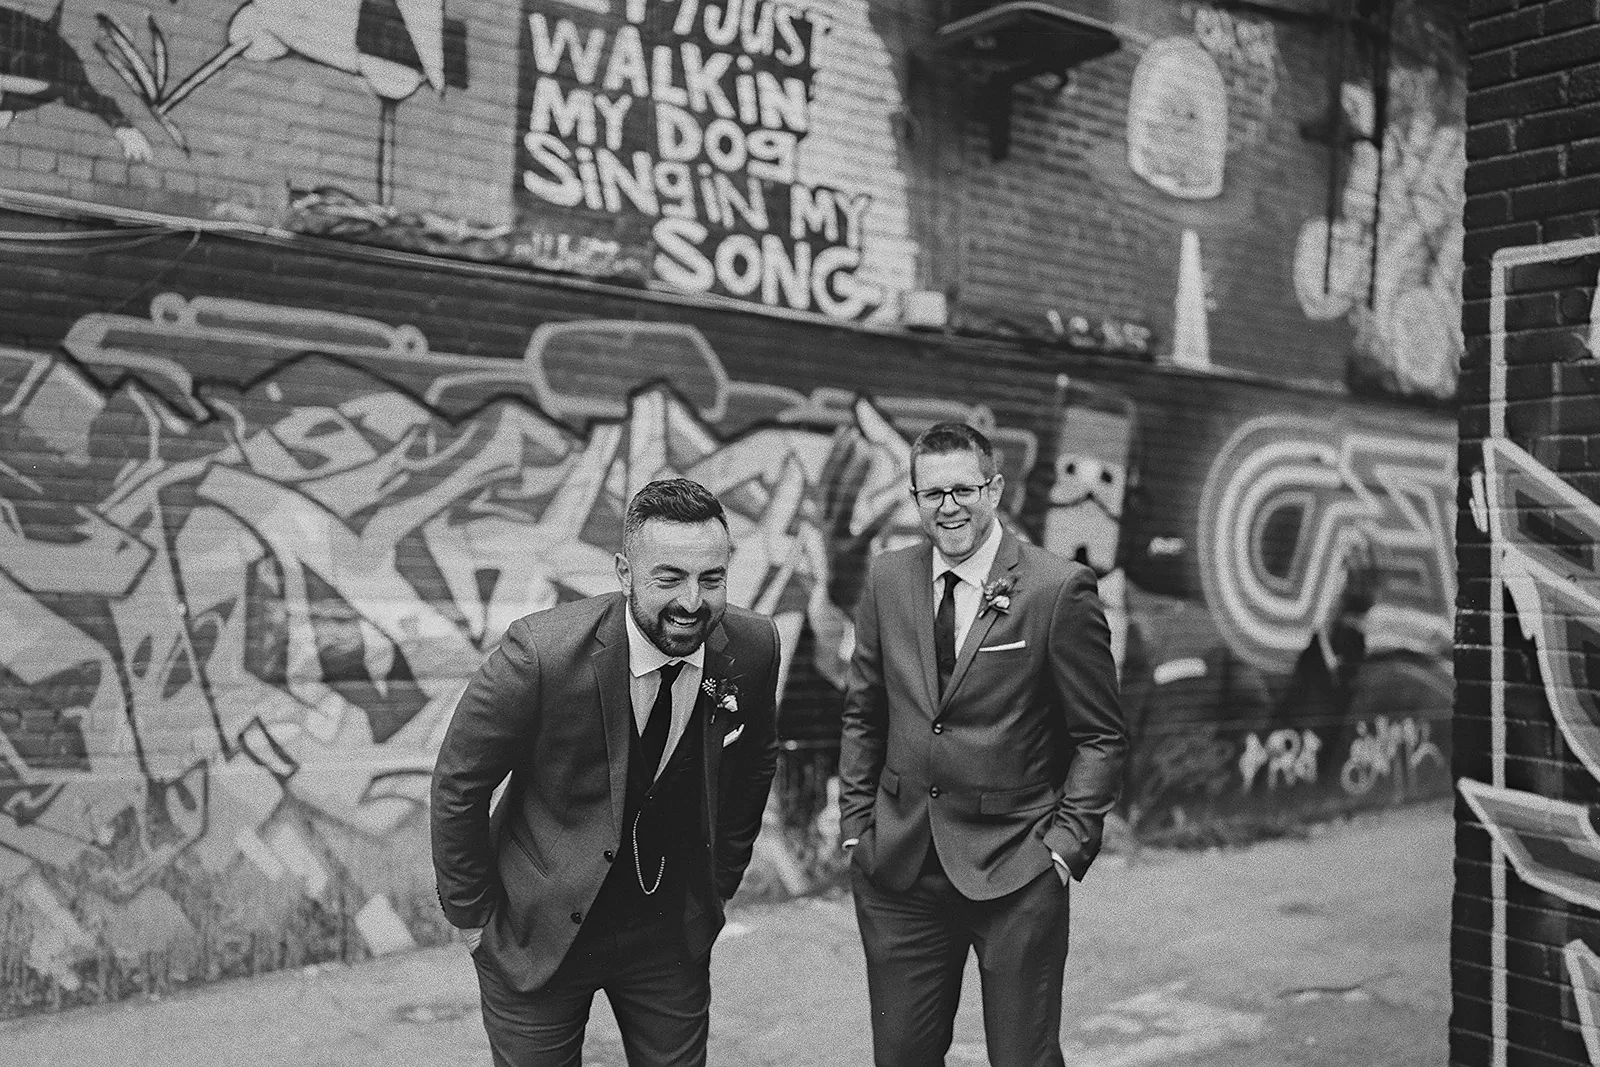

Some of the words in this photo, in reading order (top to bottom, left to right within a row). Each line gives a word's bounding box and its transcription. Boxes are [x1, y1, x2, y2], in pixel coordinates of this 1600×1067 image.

[530, 77, 632, 150] MY
[790, 184, 872, 248] MY
[653, 217, 883, 320] SONG
